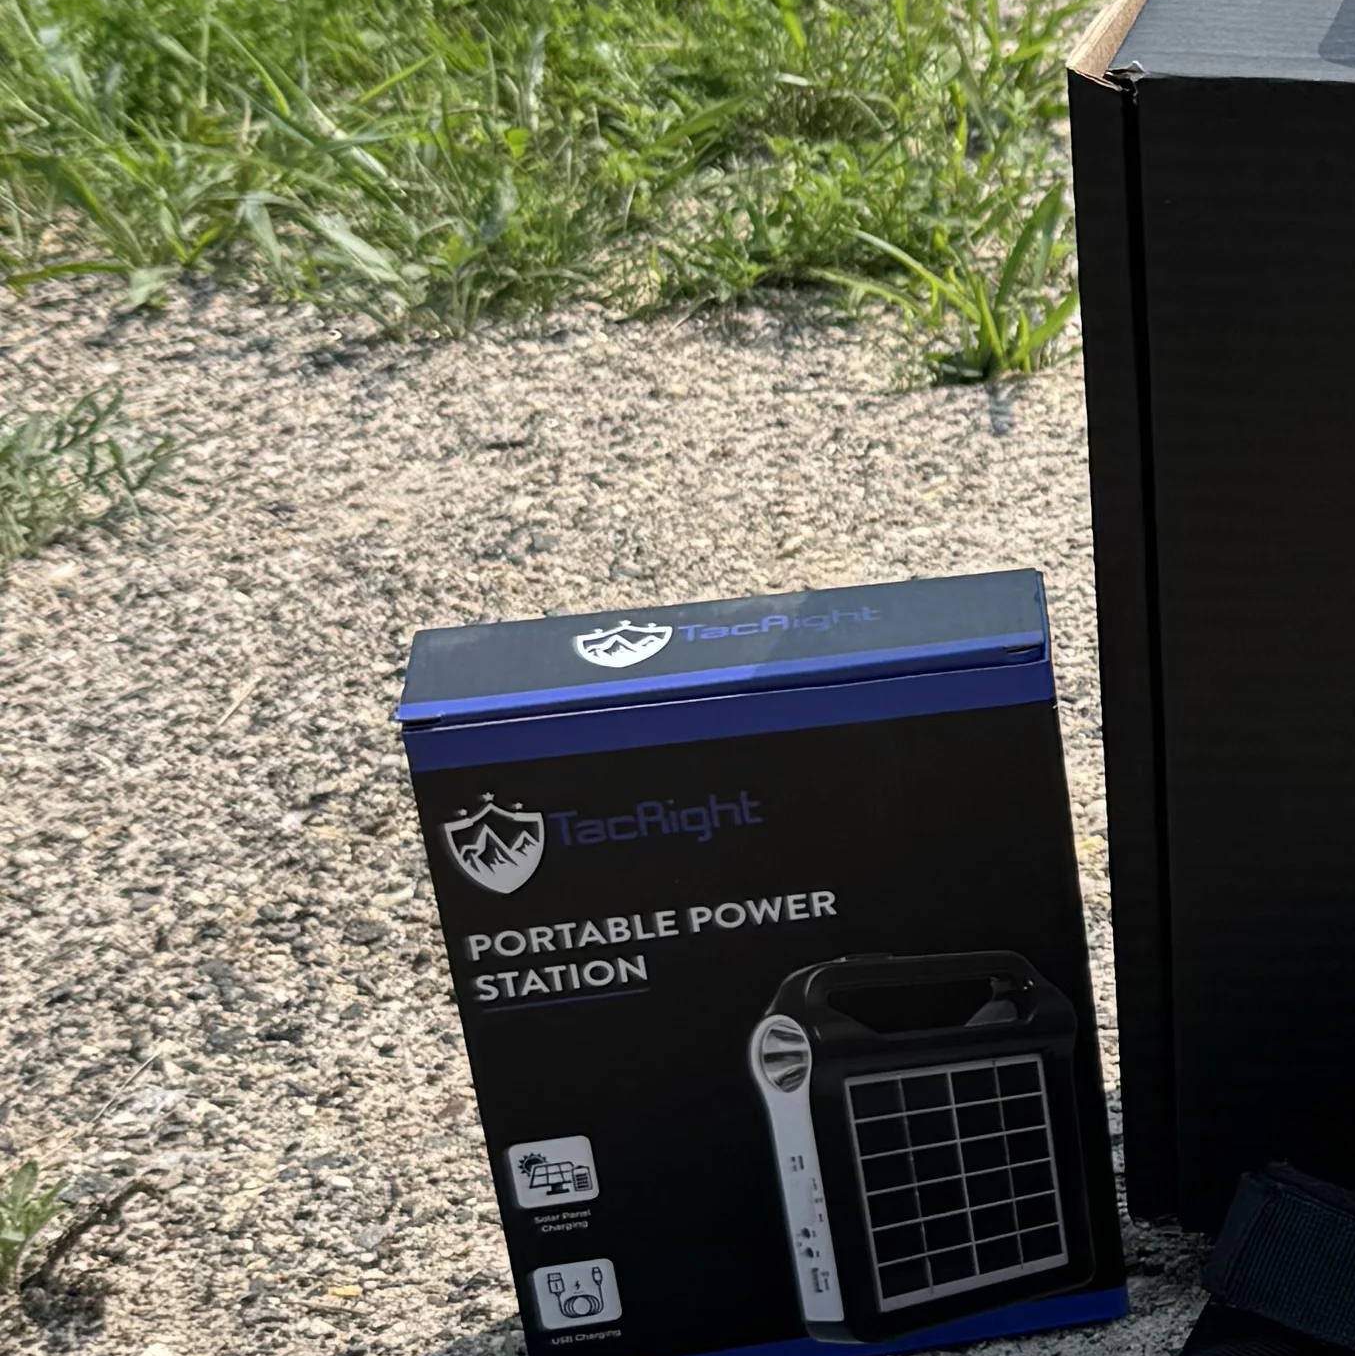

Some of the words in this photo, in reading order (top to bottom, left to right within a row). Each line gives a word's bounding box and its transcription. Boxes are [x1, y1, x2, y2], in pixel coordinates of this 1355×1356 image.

[467, 910, 680, 963] PORTABLE
[690, 890, 838, 934] POWER
[472, 954, 650, 1004] STATION
